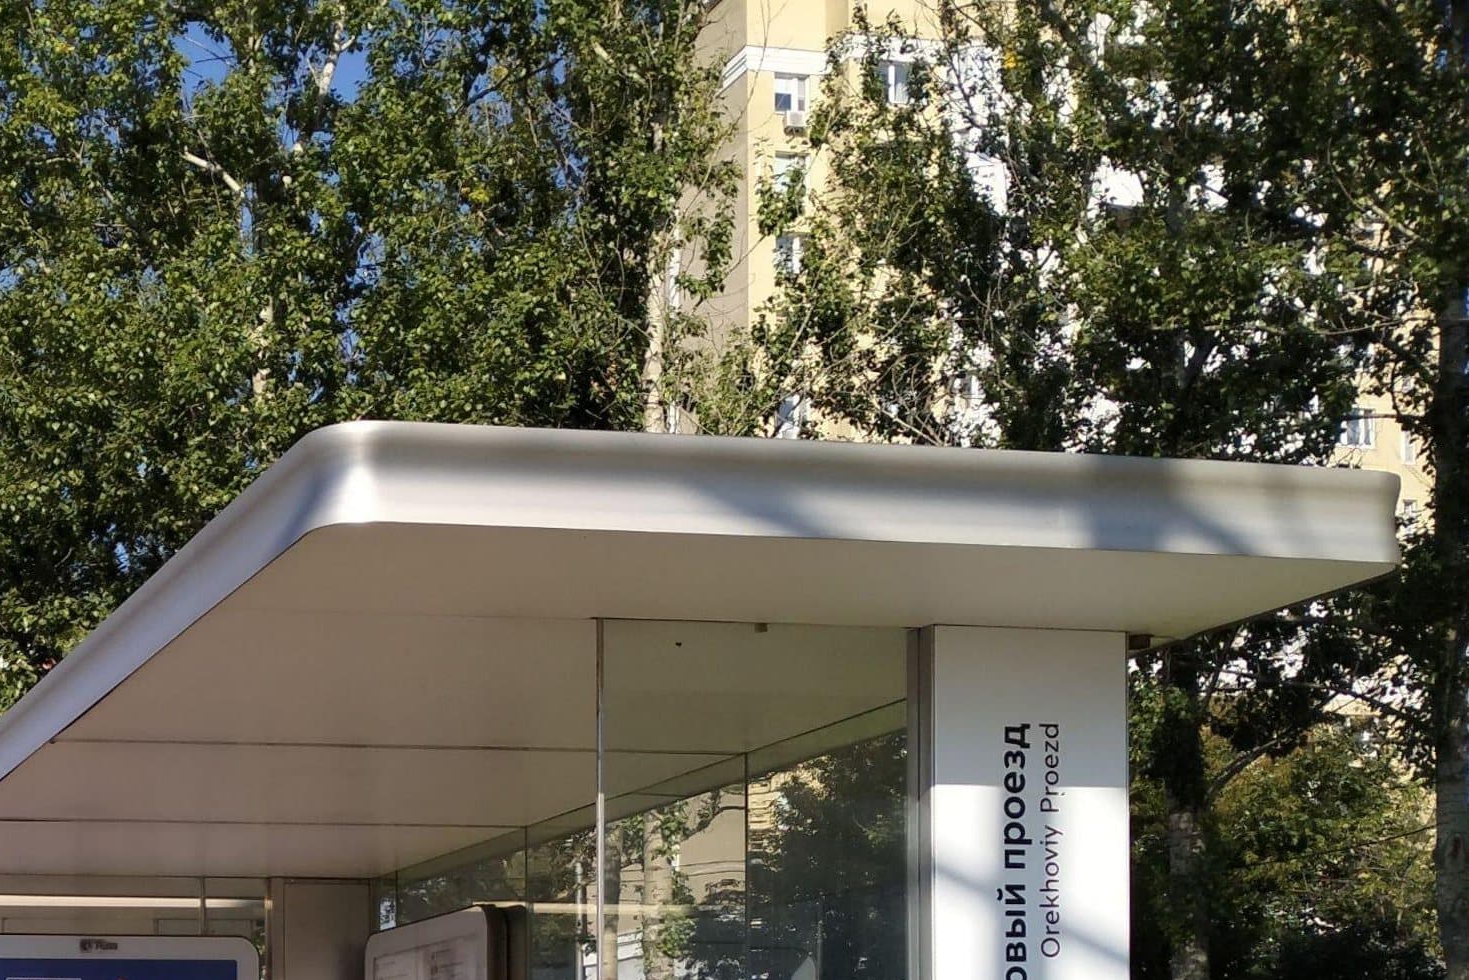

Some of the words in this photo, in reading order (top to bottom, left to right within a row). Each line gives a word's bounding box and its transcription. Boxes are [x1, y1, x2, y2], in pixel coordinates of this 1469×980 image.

[1004, 723, 1033, 870] проезд
[1039, 723, 1060, 813] Proezd
[1039, 824, 1064, 958] Orekhoviy
